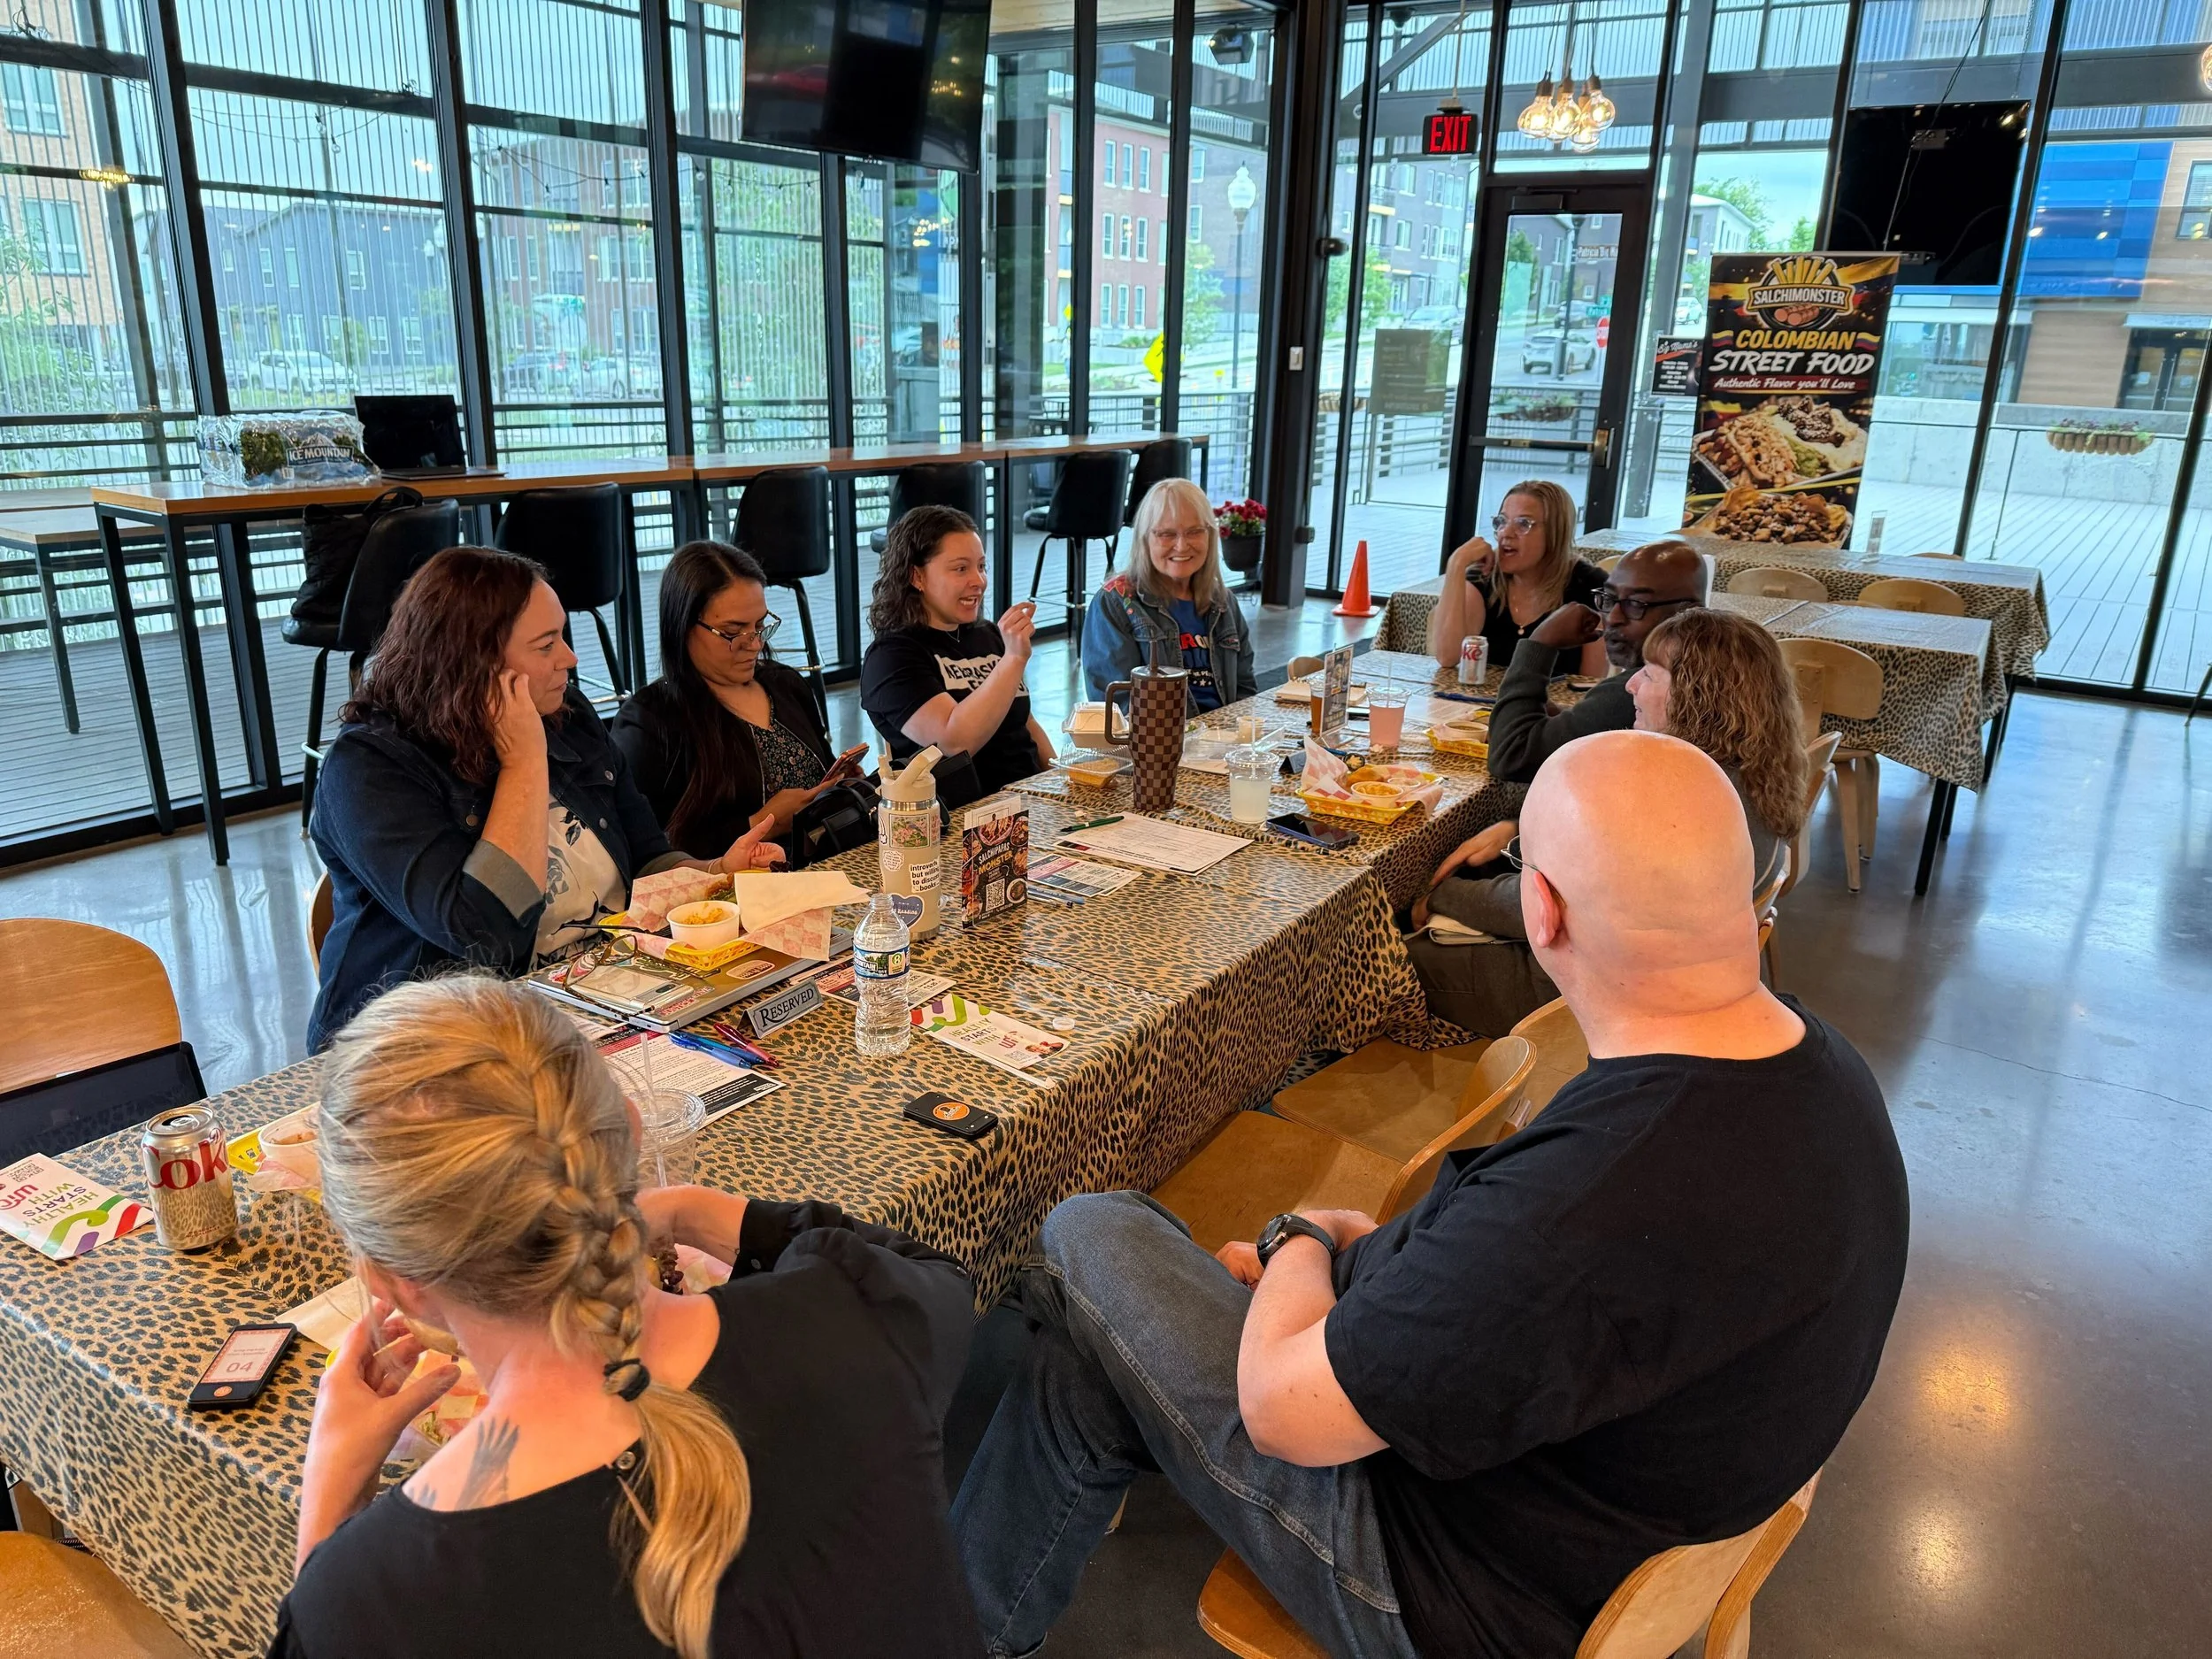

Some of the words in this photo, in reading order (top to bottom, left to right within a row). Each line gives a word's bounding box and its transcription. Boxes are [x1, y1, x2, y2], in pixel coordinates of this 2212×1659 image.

[1430, 116, 1471, 152] EXIT
[1754, 288, 1846, 305] SALCHIMONSTER
[1735, 329, 1857, 350] COLOMBIAN
[1709, 349, 1805, 375] STREET
[1806, 352, 1875, 375] FOOD
[1714, 377, 1761, 388] Authentic
[1763, 377, 1794, 388] Flavor
[1797, 377, 1828, 391] you'll
[1831, 379, 1856, 389] Love
[289, 449, 303, 461] ICE
[304, 447, 350, 458] MOUNTAIN
[1462, 643, 1483, 661] ke
[979, 842, 1010, 864] SALCHIPAPAS
[979, 850, 1013, 874] MONSTER
[759, 988, 814, 1027] RESERVED
[949, 1018, 991, 1037] HEALTHY
[960, 1026, 996, 1041] STARTS
[972, 1034, 1000, 1045] WITH
[142, 1140, 228, 1190] Cok
[23, 1187, 87, 1217] STARTS
[28, 1182, 75, 1204] WITH
[23, 1192, 99, 1227] HEALTHY
[226, 1362, 253, 1373] 04
